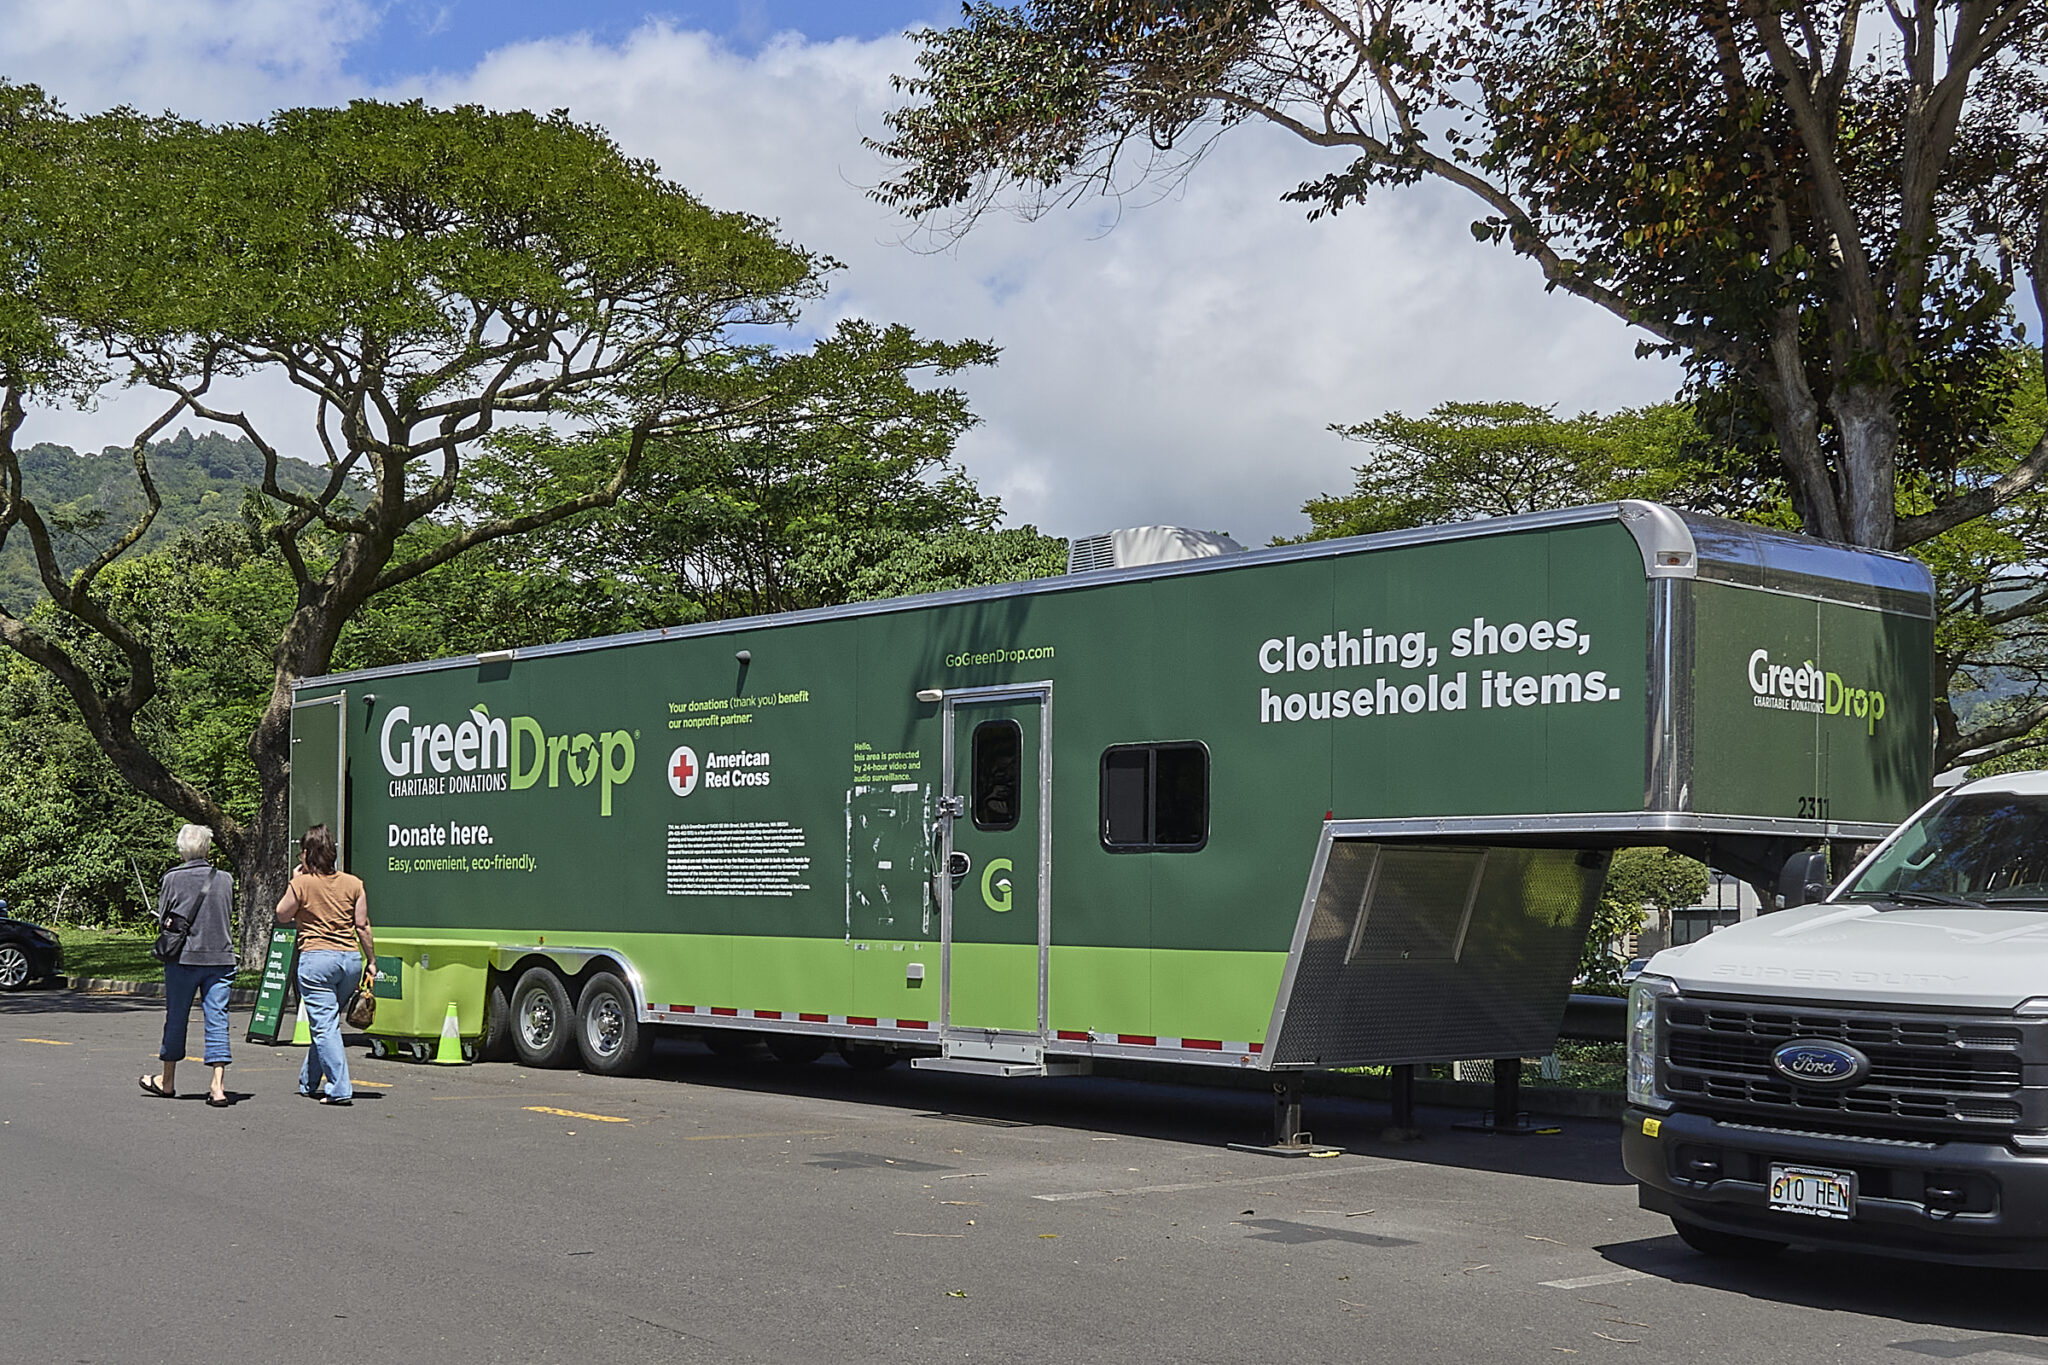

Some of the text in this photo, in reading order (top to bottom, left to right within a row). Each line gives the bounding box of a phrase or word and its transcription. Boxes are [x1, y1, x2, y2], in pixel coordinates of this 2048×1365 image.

[1258, 617, 1591, 674] Clothing, shoes,
[945, 646, 1055, 668] GoGreenDrop.com
[668, 690, 810, 714] Your donations (thank you) benefit
[1260, 670, 1621, 723] household items.
[1748, 648, 1886, 736] GreenDrop
[1753, 695, 1825, 714] CHARITABLE DONATIONS
[668, 713, 753, 730] our nonprofit partner:
[854, 742, 872, 751] Hello,
[854, 753, 865, 762] this
[881, 752, 887, 760] is
[888, 750, 920, 761] protected
[706, 750, 770, 769] American
[854, 761, 921, 774] by 24-hour video and
[389, 772, 508, 798] CHARITABLE DONATIONS
[705, 769, 770, 788] Red Cross
[853, 773, 912, 783] audio surveillance.
[388, 820, 494, 847] Donate here.
[388, 854, 537, 873] Easy, convenient, eco-friendly.
[1711, 963, 1969, 985] SUPER DUTY
[1792, 1052, 1836, 1074] Ford
[1773, 1176, 1849, 1208] 610 HEN
